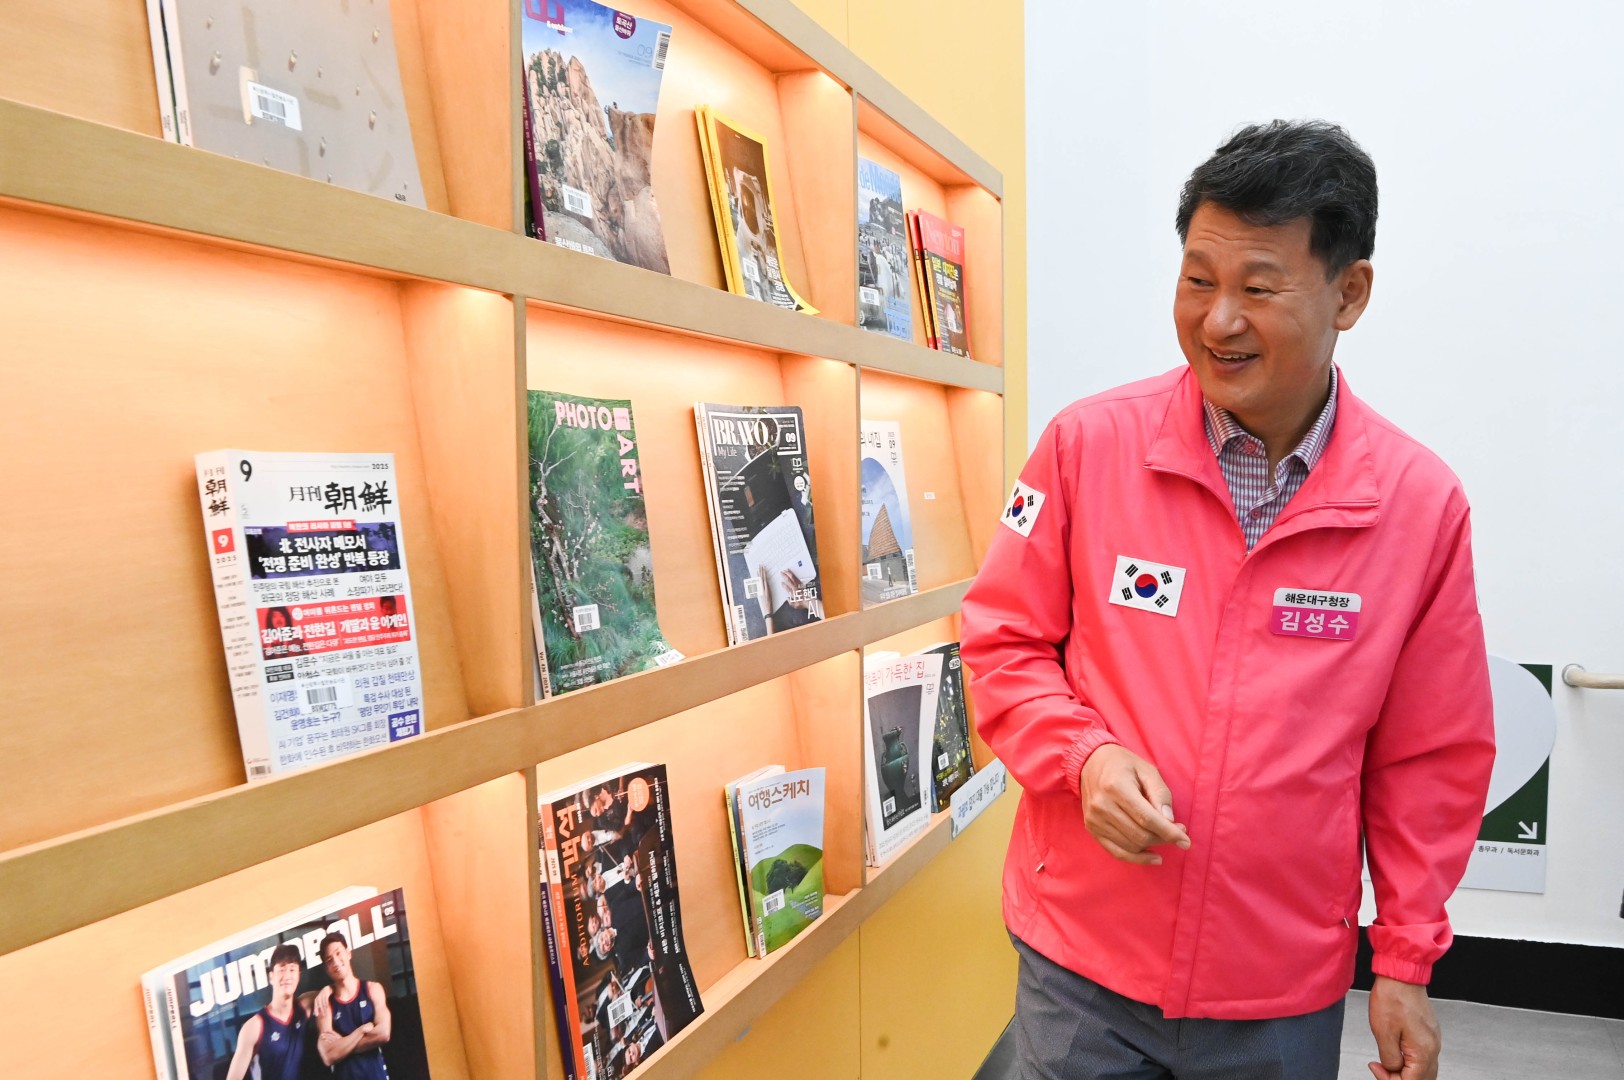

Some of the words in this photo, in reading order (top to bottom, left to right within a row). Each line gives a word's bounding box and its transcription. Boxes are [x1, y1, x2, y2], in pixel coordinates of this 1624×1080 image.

[555, 401, 613, 430] PHOTO
[713, 419, 768, 446] BRAVO
[785, 433, 797, 443] 09
[617, 433, 640, 493] ART
[718, 446, 728, 459] My
[728, 446, 738, 457] Life
[240, 459, 252, 482] 9
[371, 463, 389, 471] 2025
[324, 481, 393, 515] 朝鮮
[217, 534, 229, 548] 9
[294, 535, 333, 553] 전사자
[288, 554, 314, 571] 준비
[343, 552, 367, 567] 반복
[367, 550, 390, 566] 등장
[807, 600, 821, 620] AI
[1284, 593, 1351, 608] 해운대구청장
[261, 626, 304, 644] 김어준과
[304, 621, 337, 639] 전한길
[1279, 611, 1350, 635] 김성수
[748, 779, 810, 811] 여행스케치
[1478, 845, 1498, 853] 총무과
[1507, 848, 1540, 857] 독서문화과
[190, 904, 398, 1018] JUMBALL
